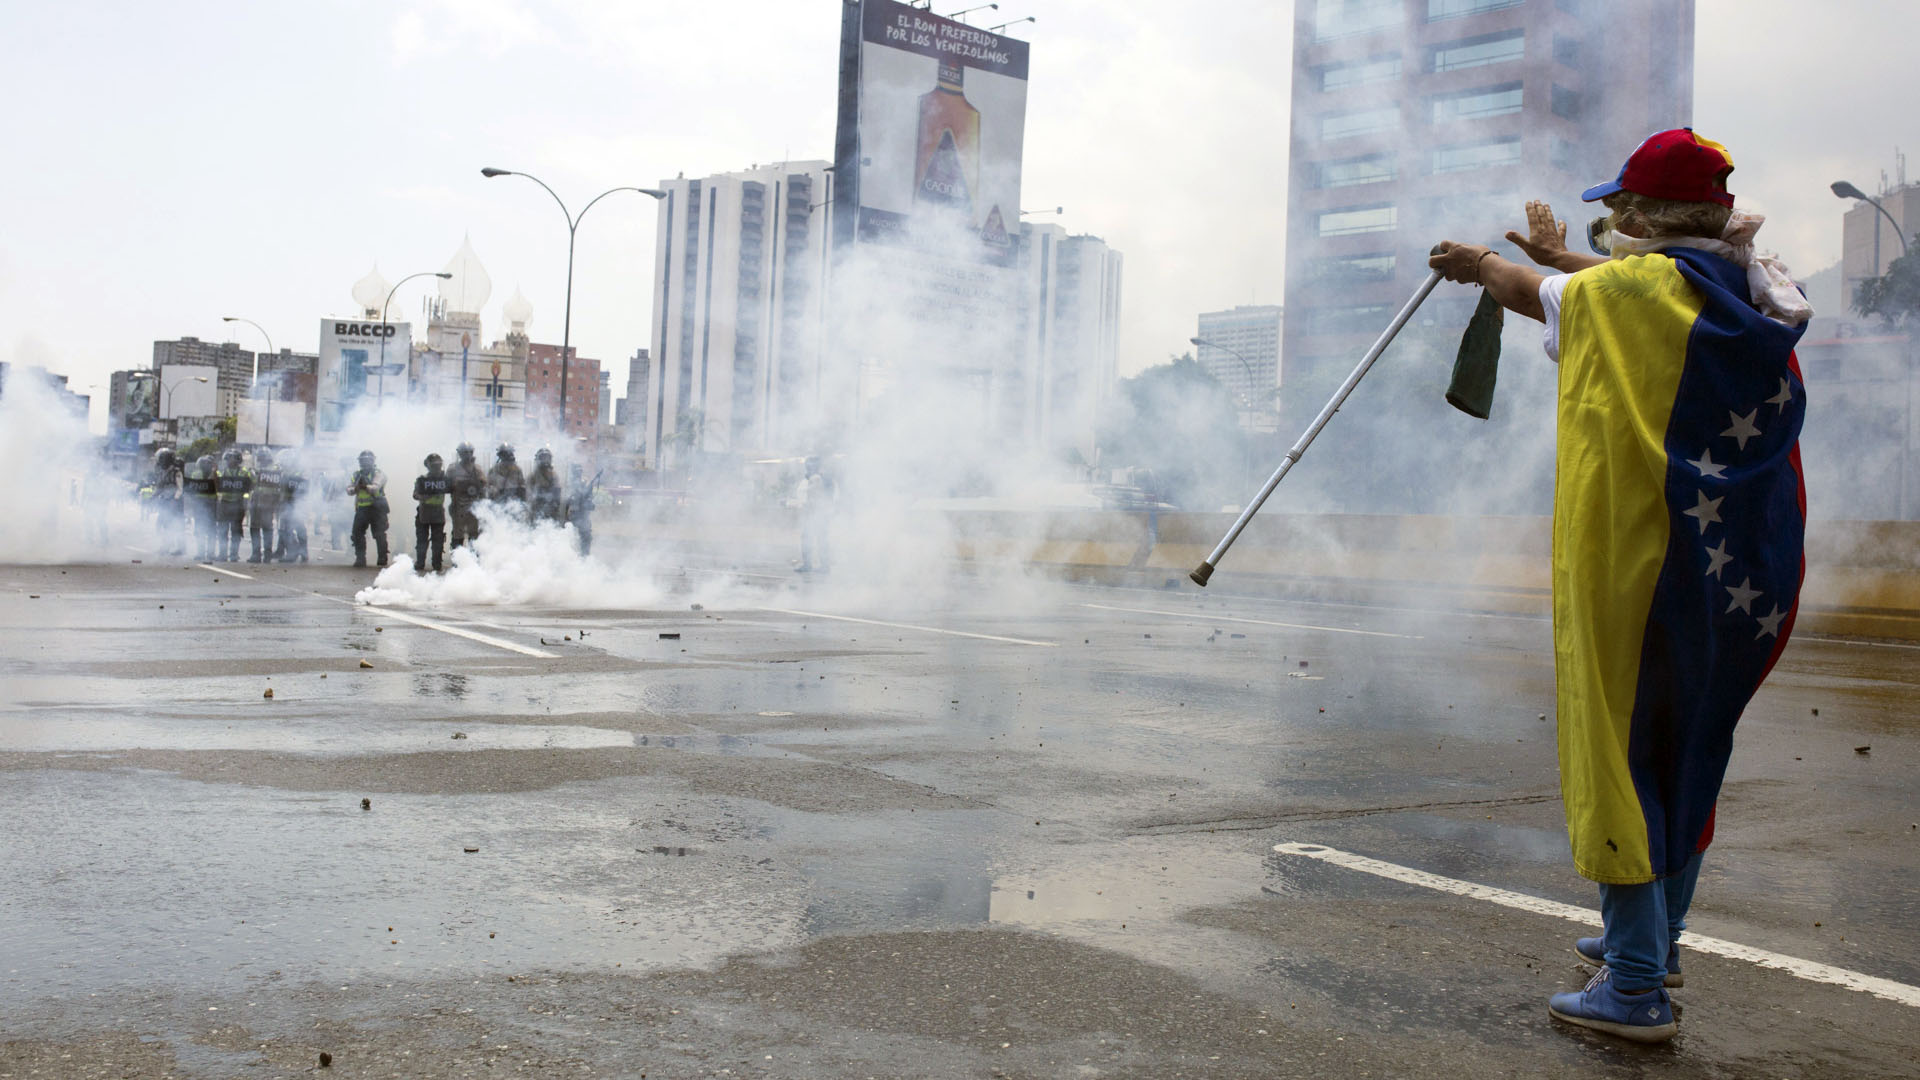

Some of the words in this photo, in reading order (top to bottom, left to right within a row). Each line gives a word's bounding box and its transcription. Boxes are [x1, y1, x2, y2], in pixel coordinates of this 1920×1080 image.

[898, 15, 911, 28] EL
[914, 17, 937, 35] RON
[941, 24, 998, 48] PREFERIDO
[886, 25, 908, 41] POR
[911, 31, 930, 47] LOS
[935, 38, 1009, 64] VENEZOLANOS
[335, 323, 396, 338] BACCO
[222, 479, 243, 489] PNB
[260, 472, 280, 484] PNB
[189, 481, 209, 490] PNB
[424, 480, 446, 490] PNB
